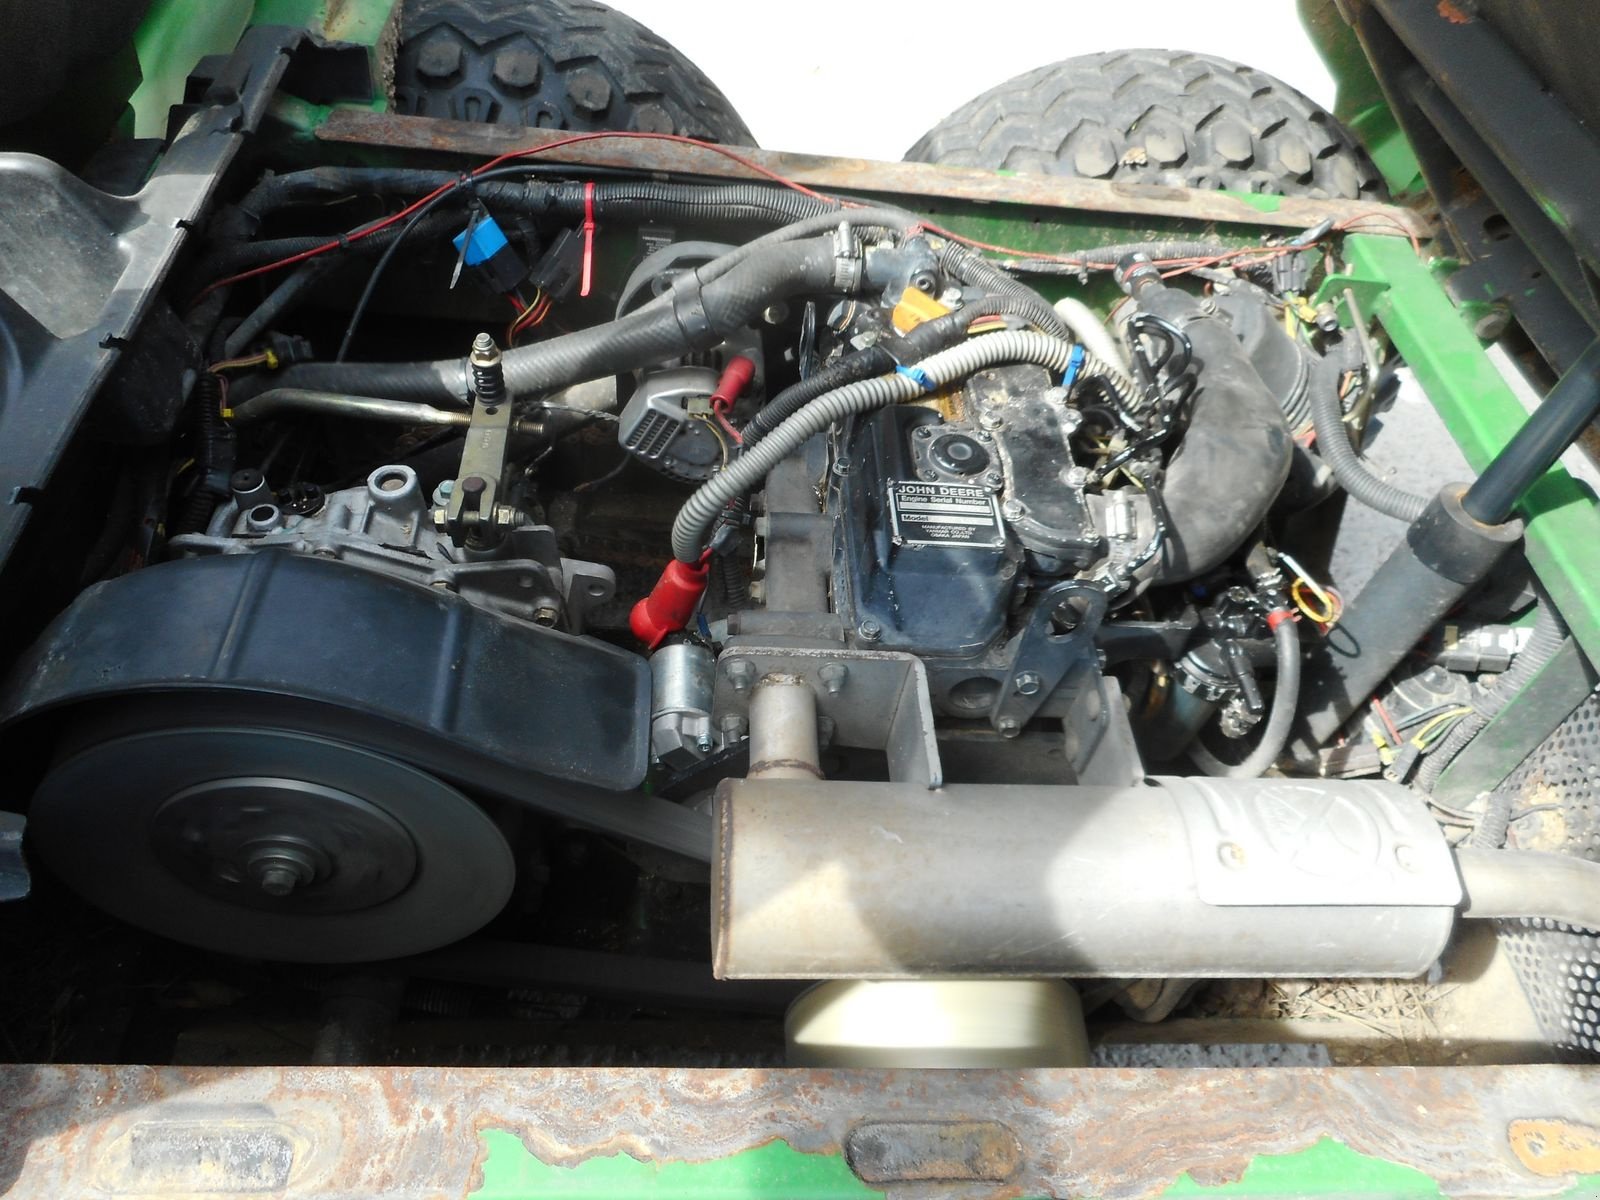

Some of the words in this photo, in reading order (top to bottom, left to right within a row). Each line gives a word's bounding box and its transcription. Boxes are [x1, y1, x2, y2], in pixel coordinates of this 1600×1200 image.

[899, 485, 935, 495] JOHN
[940, 487, 984, 498] DEERE
[901, 495, 928, 503] Engine
[903, 514, 929, 522] Model
